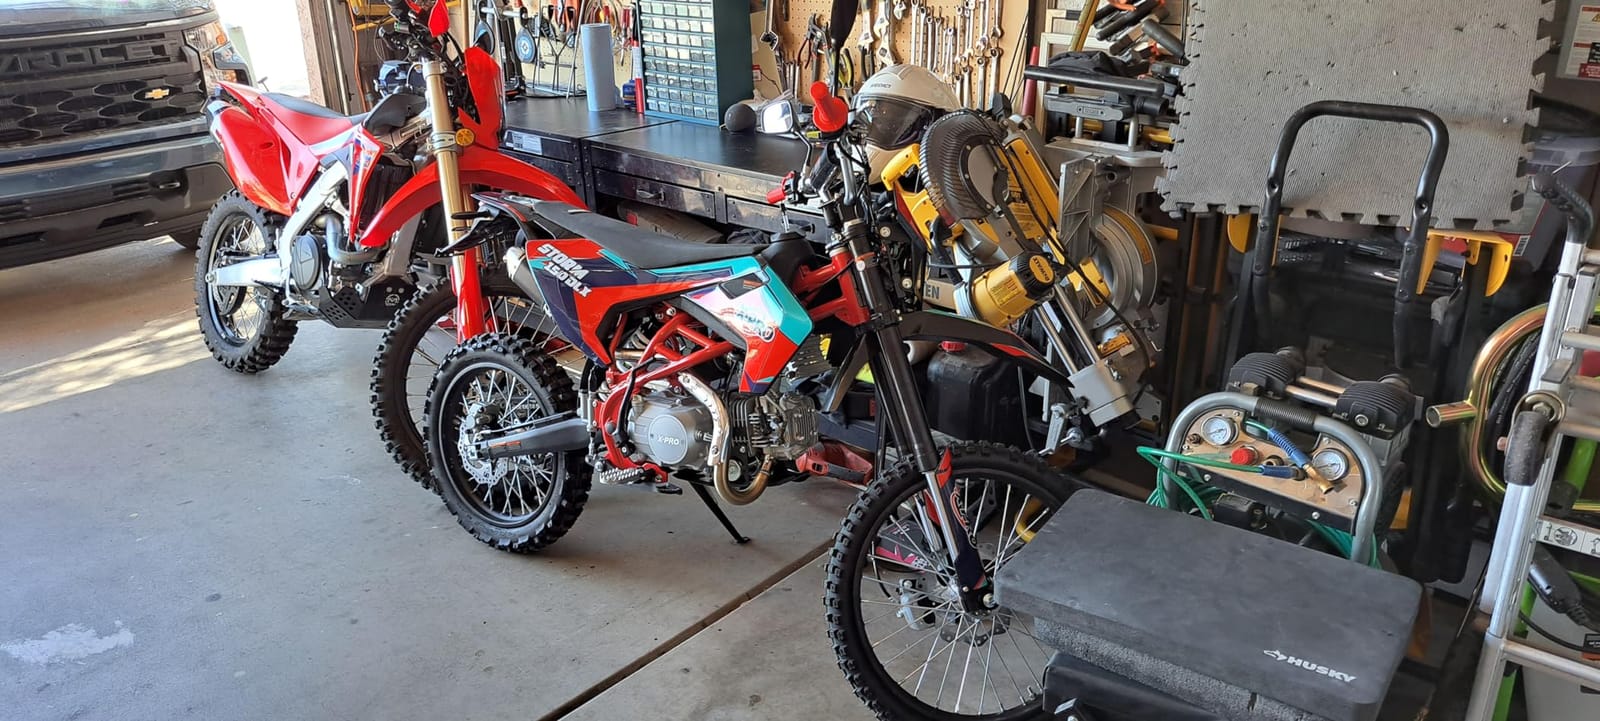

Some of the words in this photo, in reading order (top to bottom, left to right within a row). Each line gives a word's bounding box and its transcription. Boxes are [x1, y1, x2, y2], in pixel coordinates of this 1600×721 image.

[537, 244, 589, 280] STORM
[657, 435, 680, 446] X-PRO
[1287, 656, 1356, 682] HUSKY
